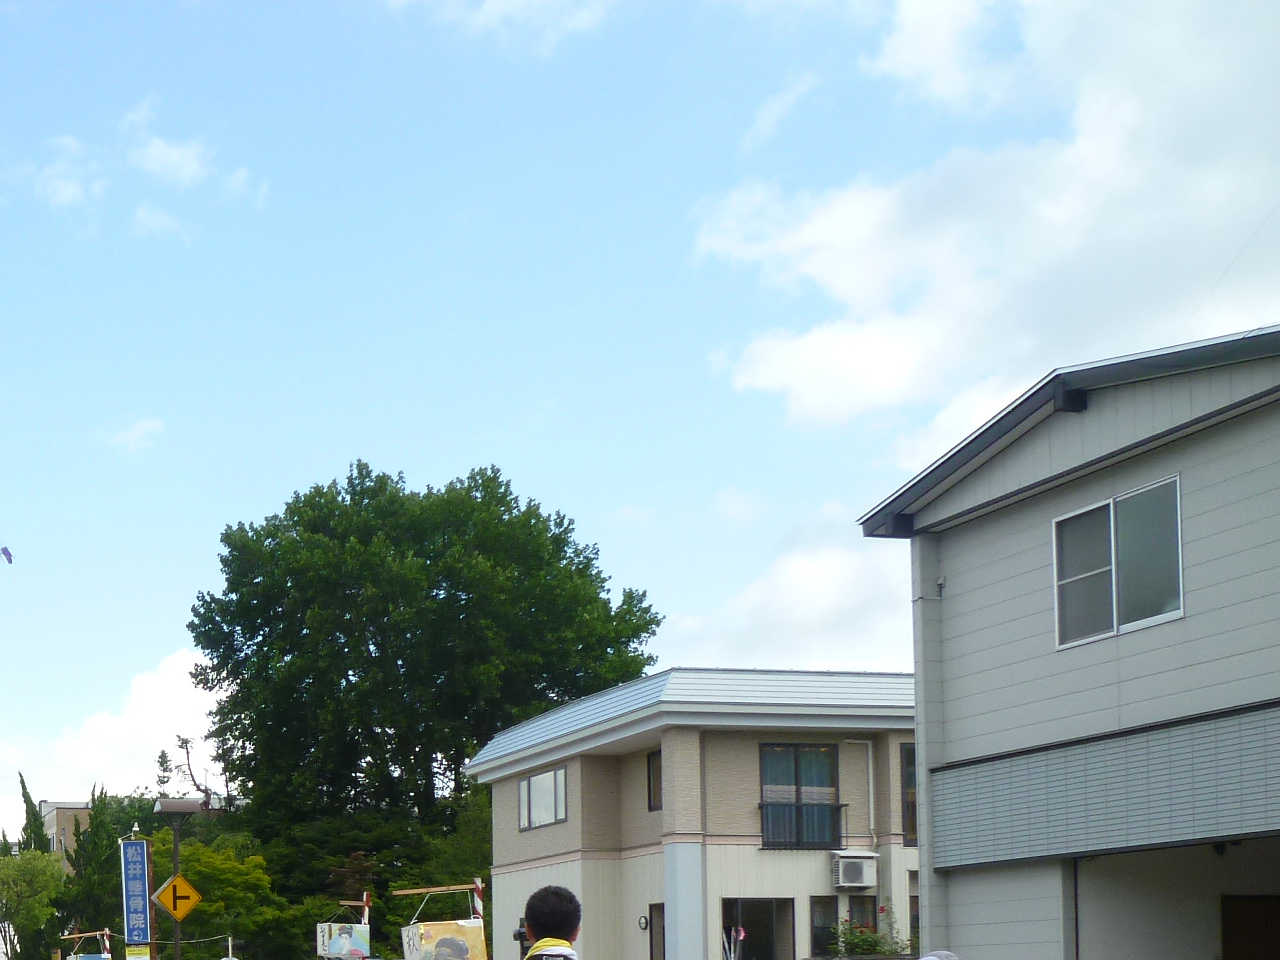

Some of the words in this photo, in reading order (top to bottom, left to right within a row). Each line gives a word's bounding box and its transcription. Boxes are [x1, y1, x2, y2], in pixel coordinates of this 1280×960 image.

[126, 845, 145, 929] 松井整骨院
